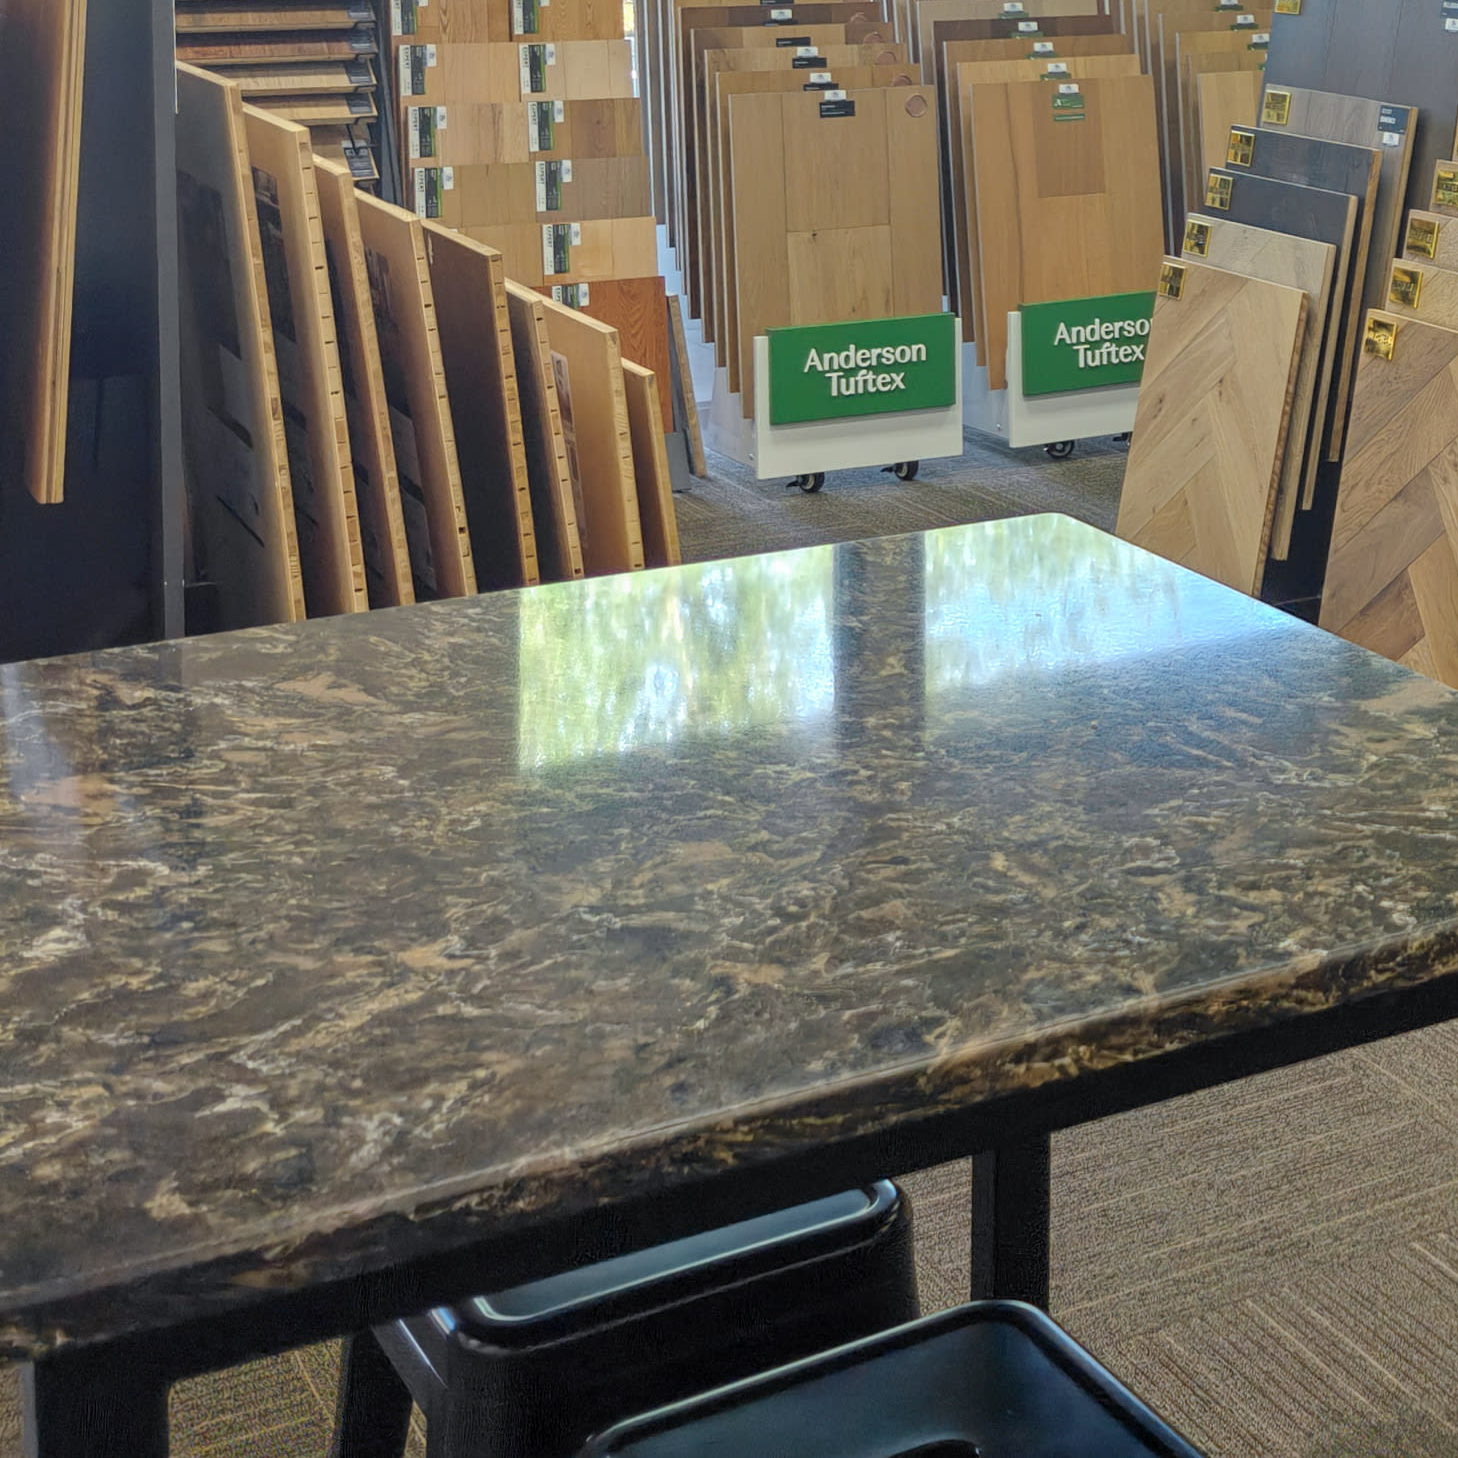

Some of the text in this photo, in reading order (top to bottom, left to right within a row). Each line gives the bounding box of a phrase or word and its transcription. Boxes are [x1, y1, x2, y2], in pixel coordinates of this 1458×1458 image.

[1053, 316, 1153, 346] Anderso
[803, 342, 927, 374] Anderson
[1072, 341, 1146, 370] Tuftex
[824, 368, 907, 398] Tuftex
